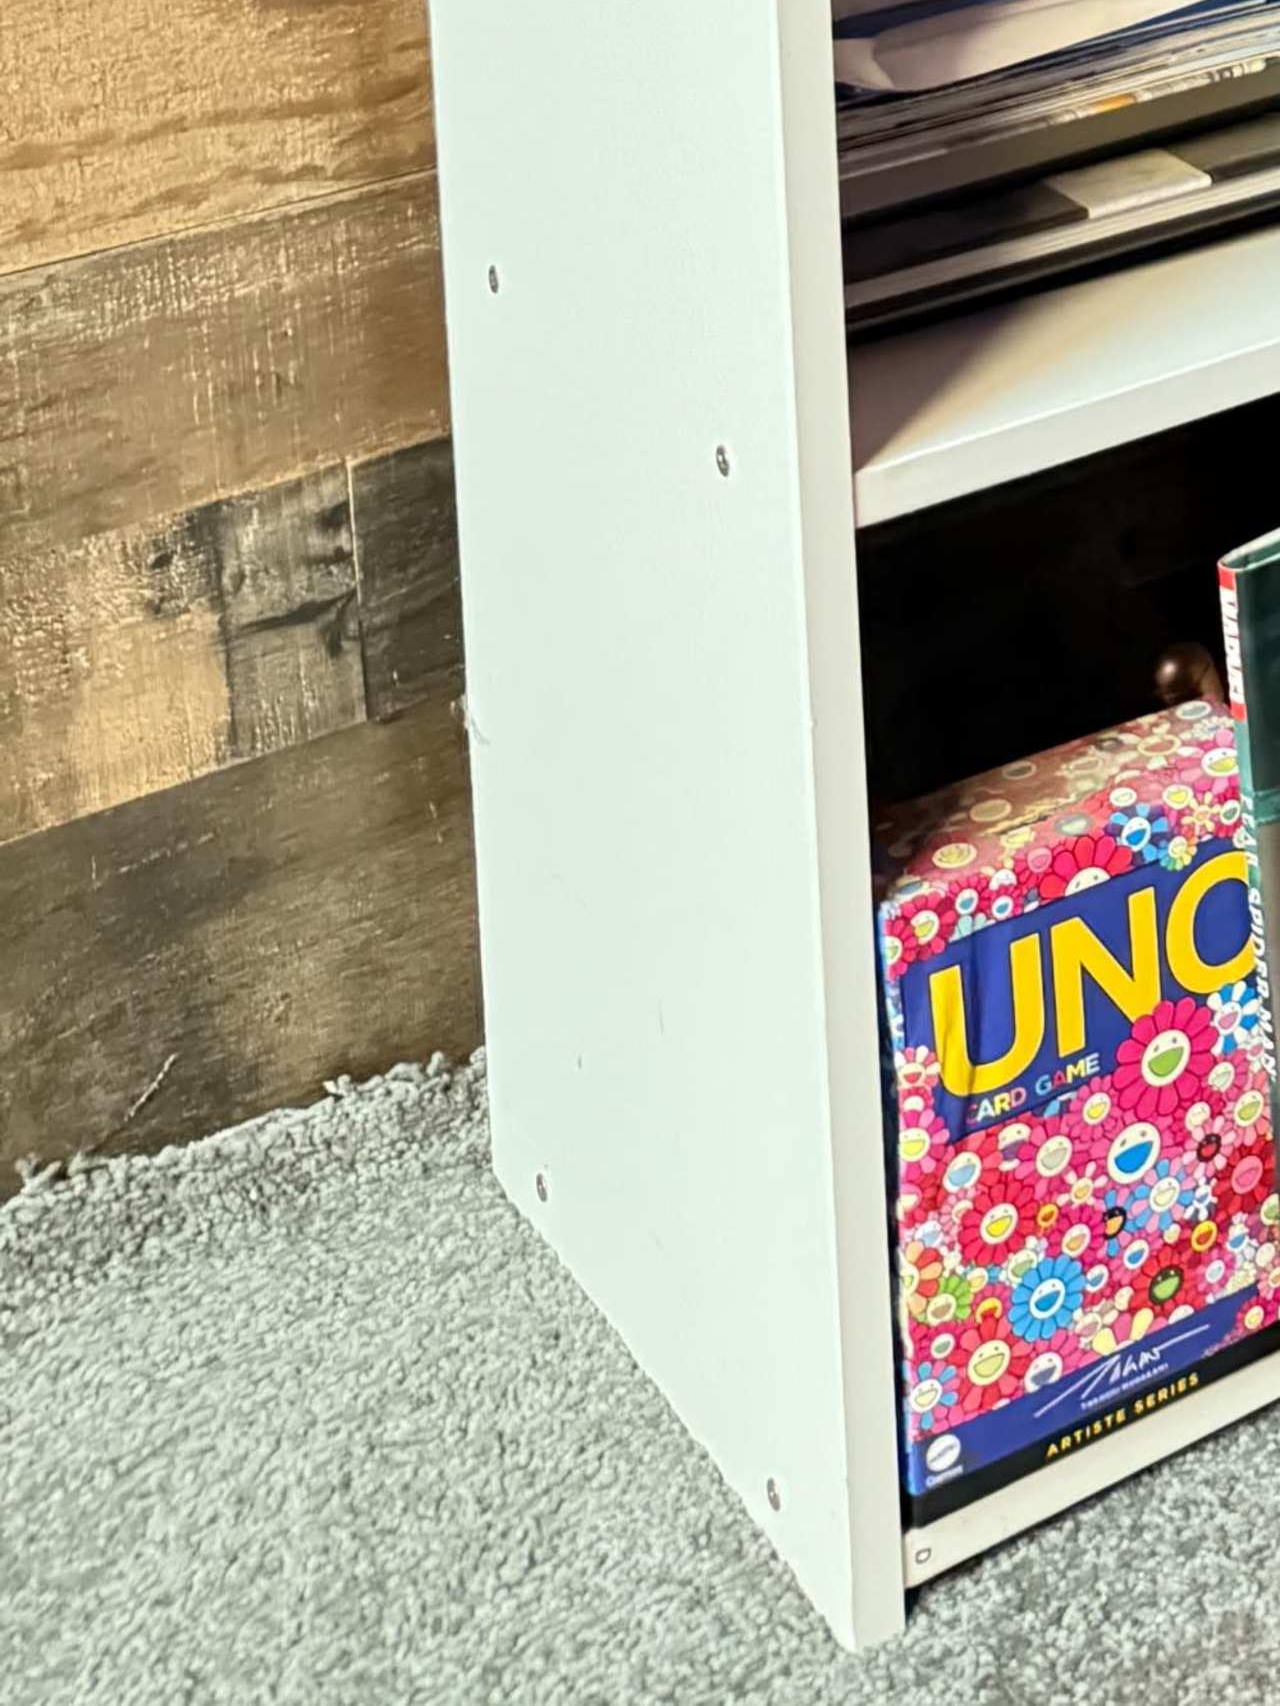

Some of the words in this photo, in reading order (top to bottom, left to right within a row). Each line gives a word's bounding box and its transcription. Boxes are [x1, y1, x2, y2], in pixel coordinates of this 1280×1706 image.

[929, 850, 1257, 1098] UNO
[1034, 1052, 1100, 1097] GAME
[1045, 1408, 1127, 1458] ARTISTE
[1134, 1373, 1200, 1415] SERIES
